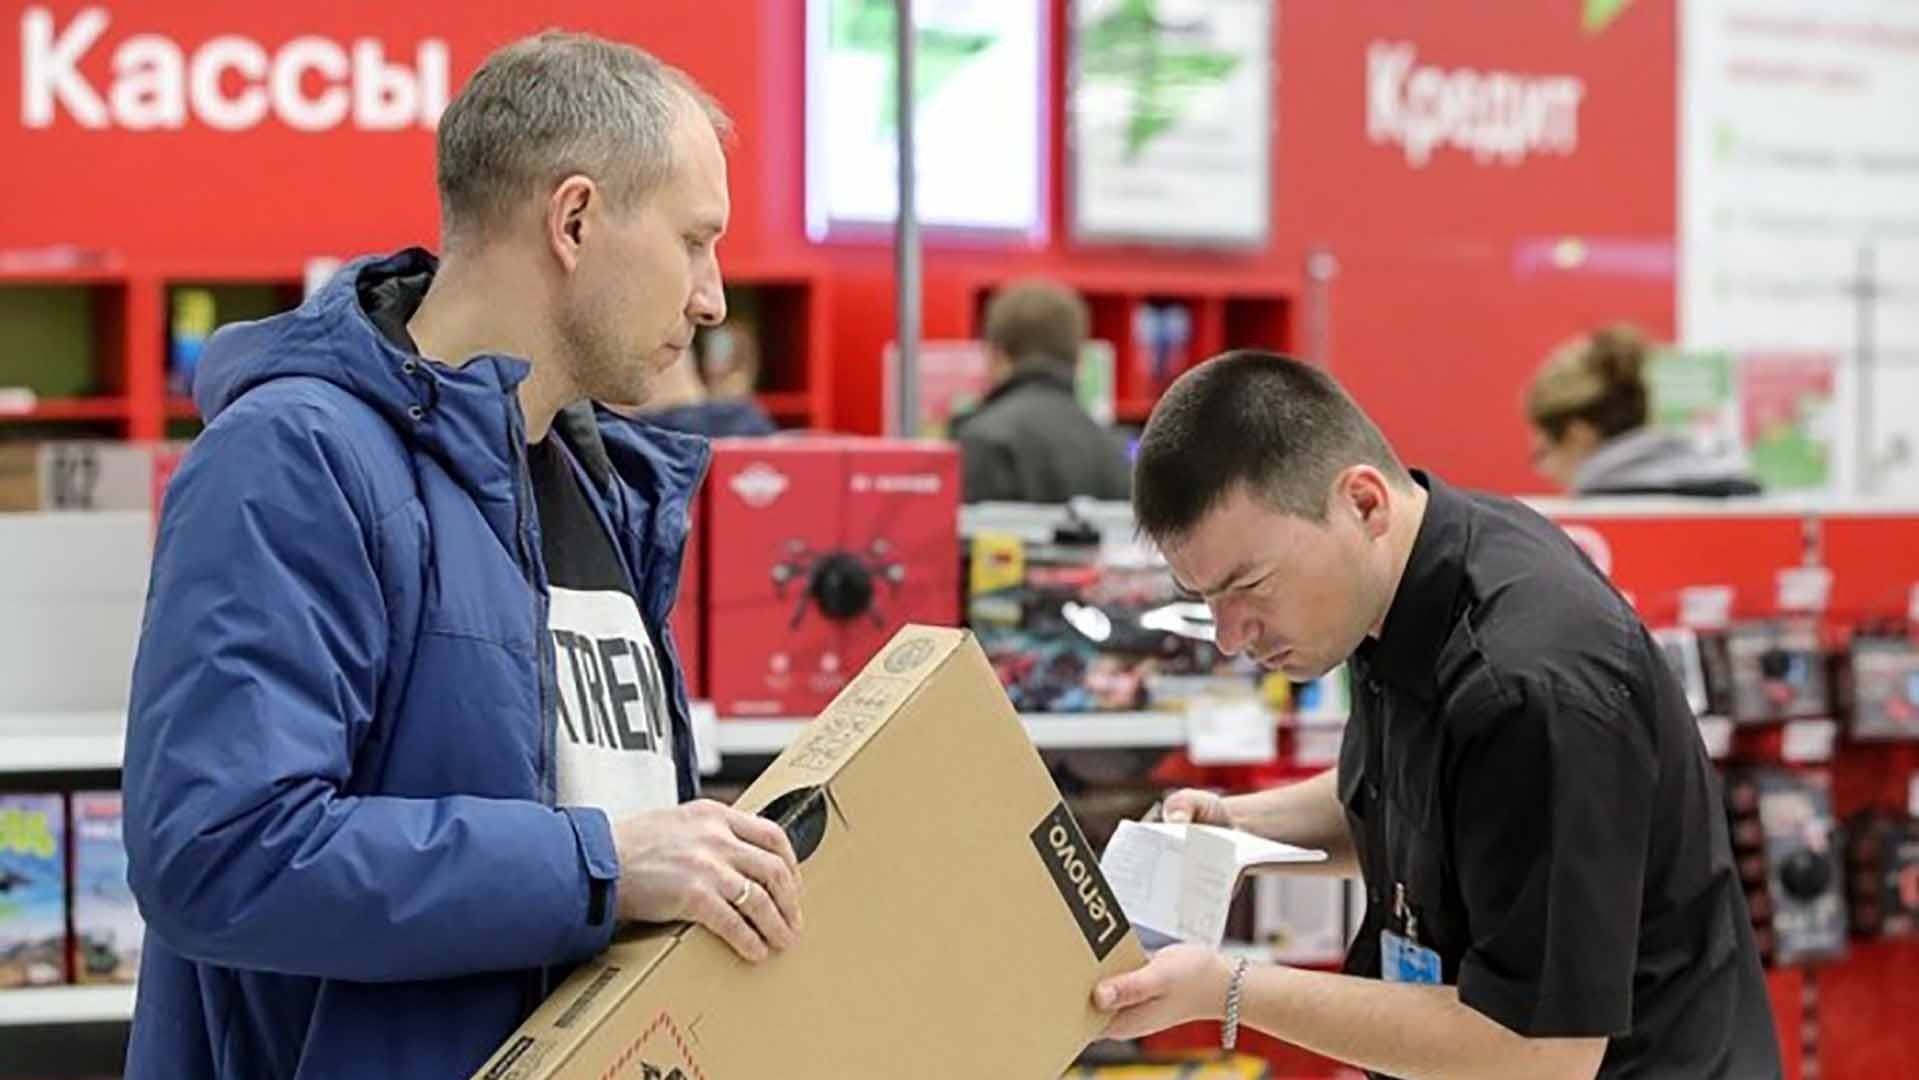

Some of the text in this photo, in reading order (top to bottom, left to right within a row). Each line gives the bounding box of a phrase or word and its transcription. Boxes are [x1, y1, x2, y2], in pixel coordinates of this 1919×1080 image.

[19, 5, 450, 132] Кассы
[1365, 40, 1587, 169] Кредит
[1049, 824, 1117, 943] Lenovo
